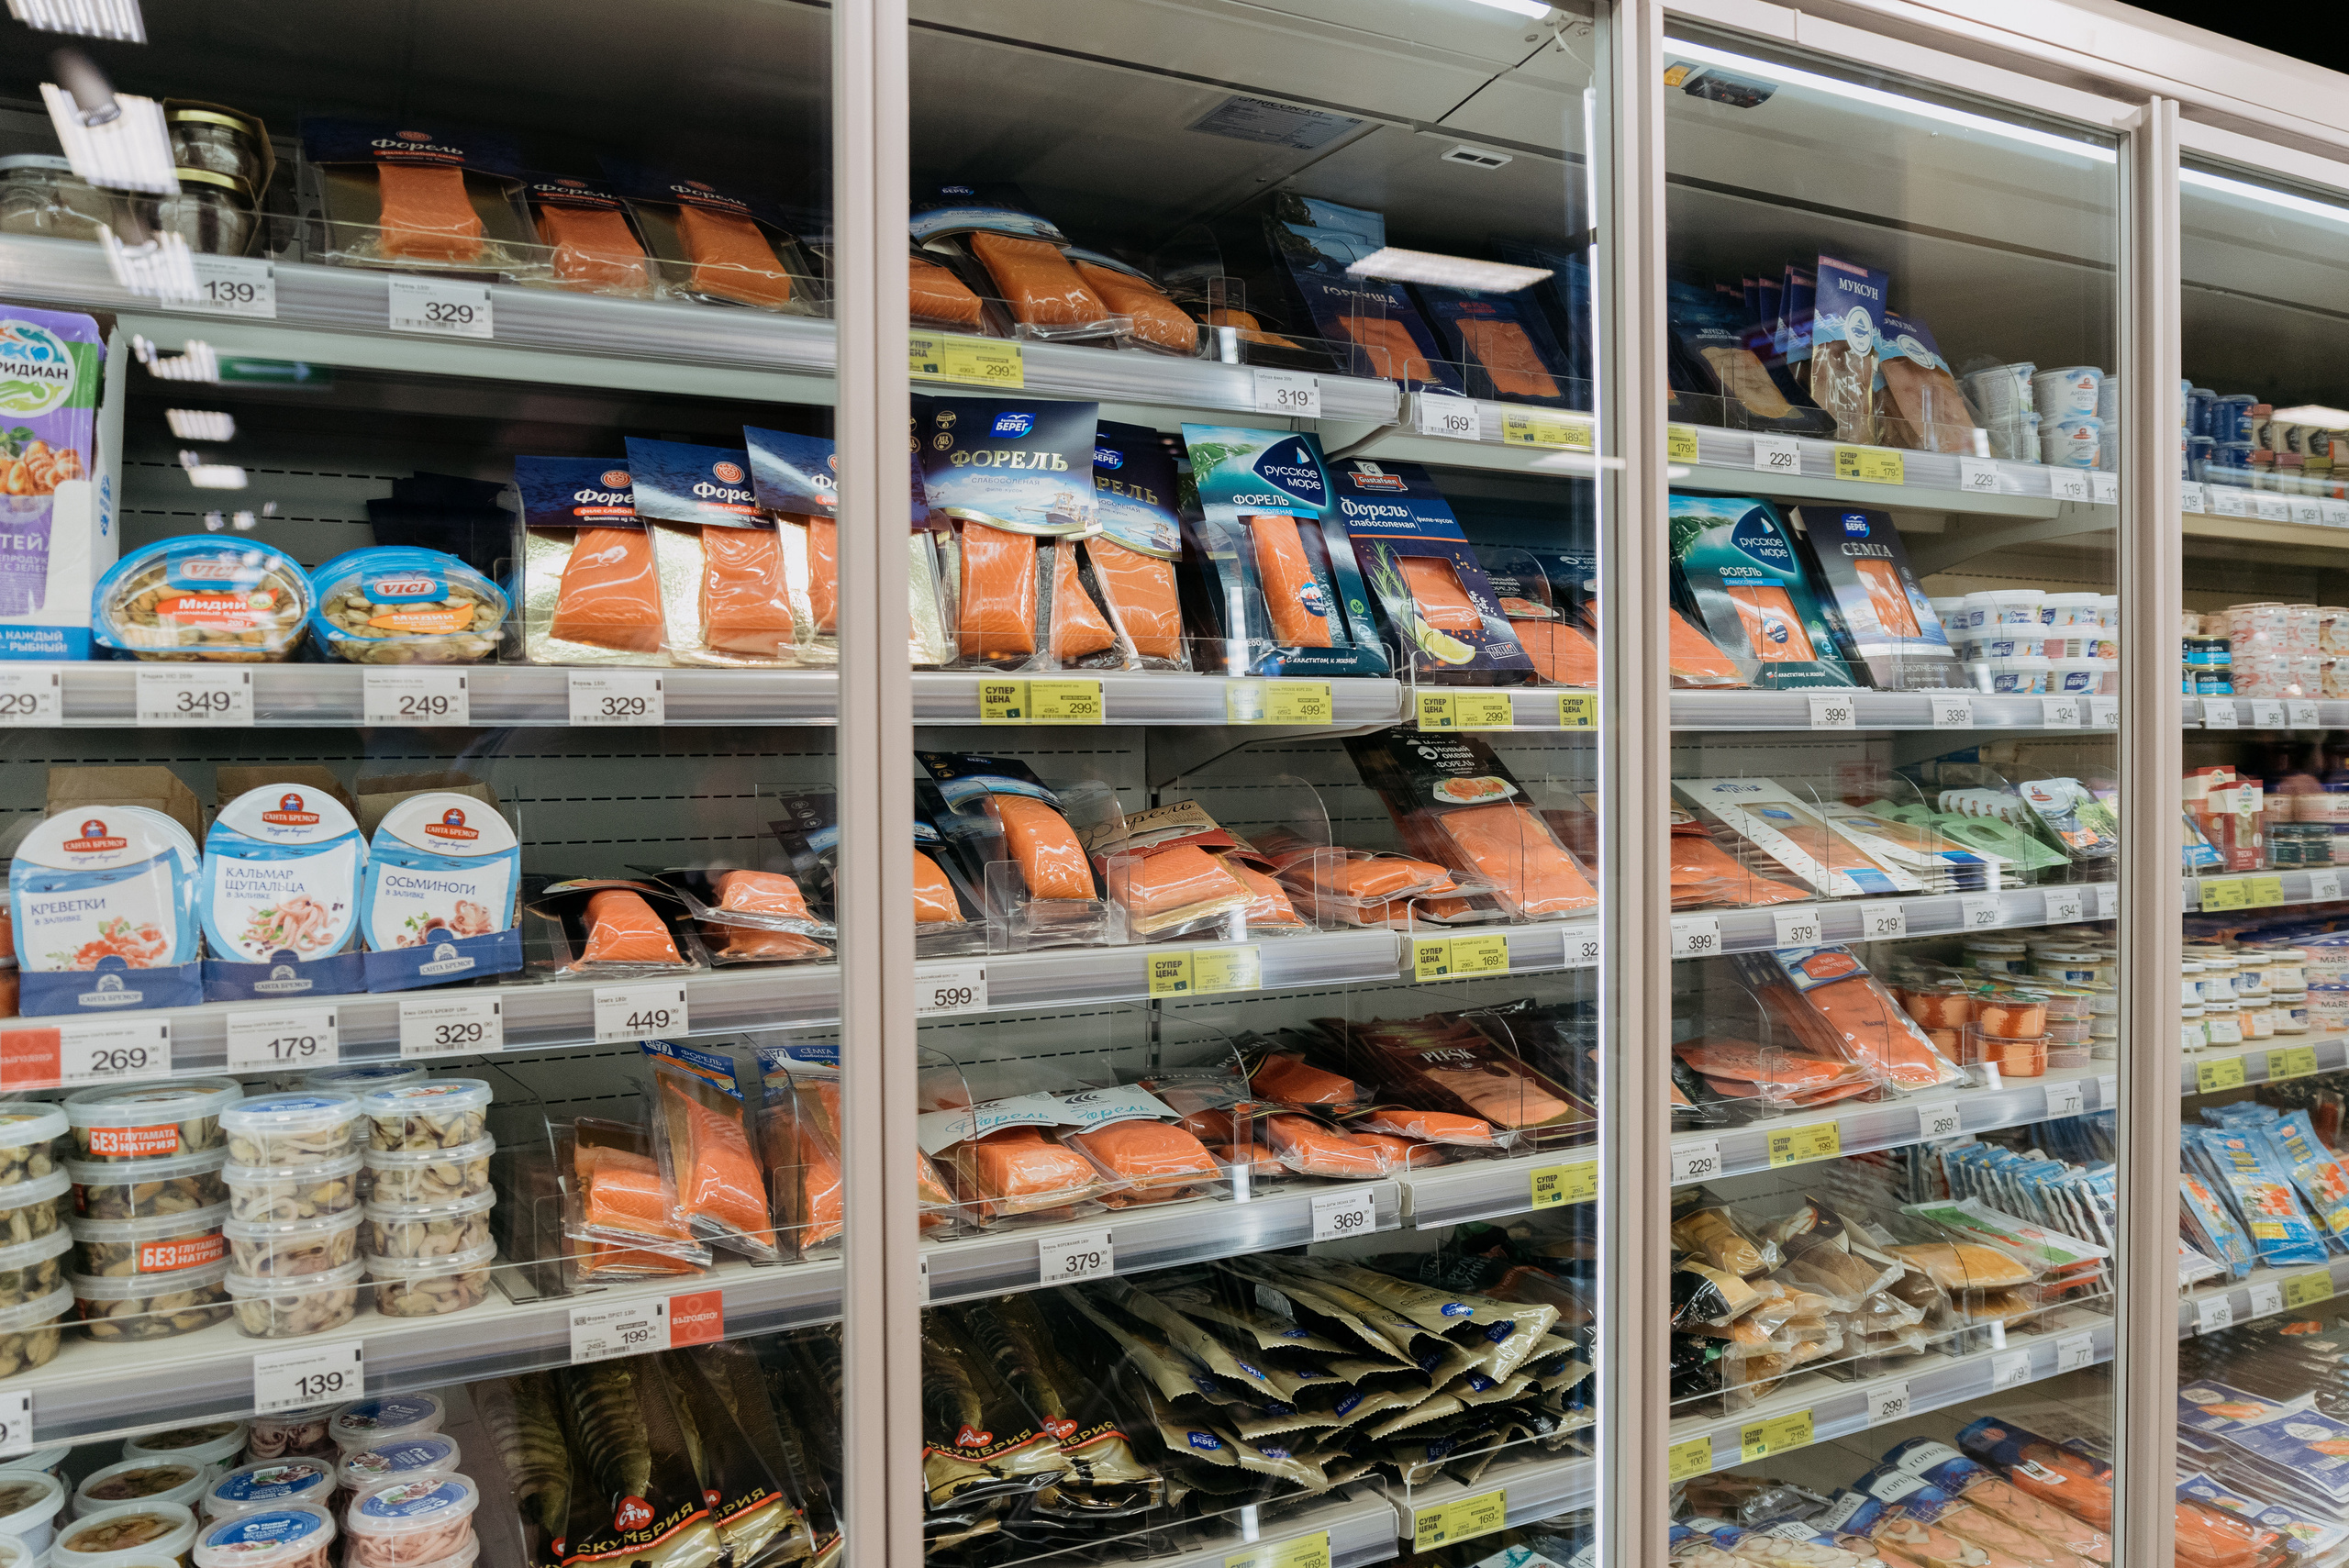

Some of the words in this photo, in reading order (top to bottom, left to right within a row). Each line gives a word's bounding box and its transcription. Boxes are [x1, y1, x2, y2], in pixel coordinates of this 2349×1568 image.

[371, 139, 463, 156] Форель
[670, 184, 748, 207] Форель
[204, 280, 255, 303] 139
[1839, 277, 1879, 301] МУКСУН
[425, 301, 474, 324] 329
[986, 365, 1010, 377] 299
[1277, 389, 1308, 406] 319
[996, 422, 1029, 432] БЕРЕГ
[1442, 415, 1468, 431] 169
[1563, 432, 1579, 442] 189
[1675, 443, 1691, 453] 179
[950, 450, 1069, 473] ФОРЕЛЬ
[1770, 451, 1792, 467] 229
[1840, 458, 1855, 466] ЦЕНА
[1264, 463, 1319, 479] русское
[1883, 468, 1897, 477] 179
[1286, 477, 1322, 491] море
[1358, 475, 1398, 485] Gustafsen
[1974, 473, 1994, 487] 229
[2064, 483, 2081, 495] 119
[573, 489, 635, 508] Форе
[1233, 494, 1289, 506] ФОРЕЛЬ
[580, 507, 601, 516] филе
[1341, 496, 1408, 520] Форель
[1416, 516, 1454, 526] филе-кусок
[1349, 518, 1416, 529] слабосоленая
[1845, 521, 1867, 532] БЕРЕГ
[1739, 536, 1784, 549] русское
[1759, 548, 1788, 559] море
[1841, 541, 1894, 558] СЁМГА
[1719, 566, 1763, 578] ФОРЕЛЬ
[384, 583, 428, 596] VICI
[178, 598, 247, 612] Мидии
[6, 630, 64, 642] КАЖДЫЙ
[2066, 677, 2088, 686] БЕРЕГ
[985, 685, 1016, 697] СУПЕР
[176, 691, 230, 712] 349
[399, 695, 450, 715] 249
[602, 696, 646, 717] 329
[985, 695, 1011, 707] ЦЕНА
[1423, 698, 1448, 707] СУПЕР
[1562, 698, 1585, 706] СУПЕР
[1069, 702, 1092, 716] 299
[1300, 706, 1320, 717] 499
[1423, 706, 1444, 716] ЦЕНА
[1563, 706, 1581, 715] ЦЕНА
[1825, 708, 1847, 722] 399
[1946, 709, 1966, 722] 339
[2056, 707, 2074, 720] 124
[1486, 711, 1504, 723] 299
[1433, 745, 1471, 753] Новый
[1436, 761, 1475, 769] ФОРЕЛЬ
[263, 812, 285, 821] САНТА
[426, 825, 449, 836] САНТА
[450, 828, 478, 839] БРЕМОР
[226, 867, 294, 880] КАЛЬМАР
[225, 880, 306, 894] ЩУПАЛЬЦА
[385, 874, 476, 896] ОСЬМИНОГИ
[30, 897, 106, 917] КРЕВЕТКИ
[2059, 905, 2076, 917] 134
[1976, 910, 1995, 924] 229
[1876, 917, 1898, 932] 219
[1791, 926, 1812, 941] 379
[1688, 934, 1712, 950] 399
[1420, 947, 1443, 956] СУПЕР
[1155, 960, 1184, 970] СУПЕР
[1420, 955, 1440, 964] ЦЕНА
[1481, 955, 1499, 967] 169
[1819, 956, 1836, 965] РЫБА
[1155, 969, 1180, 980] ЦЕНА
[934, 987, 972, 1007] 599
[626, 1009, 669, 1030] 449
[435, 1022, 484, 1045] 329
[267, 1036, 317, 1059] 179
[801, 1047, 834, 1055] СЁМГА
[91, 1048, 148, 1072] 269
[681, 1049, 723, 1067] ФОРЕЛЬ
[2065, 1096, 2076, 1110] 77
[1933, 1118, 1954, 1133] 269
[91, 1130, 118, 1152] БЕЗ
[119, 1129, 176, 1142] ГЛУТАМАТА
[119, 1140, 176, 1152] НАТРИЯ
[1773, 1137, 1791, 1146] СУПЕР
[1818, 1140, 1831, 1152] 199
[1773, 1144, 1789, 1153] ЦЕНА
[1688, 1158, 1713, 1174] 229
[1536, 1174, 1558, 1184] СУПЕР
[1537, 1183, 1555, 1193] ЦЕНА
[1333, 1210, 1364, 1230] 369
[142, 1245, 177, 1268] БЕЗ
[178, 1246, 224, 1264] НАТРИЯ
[1065, 1251, 1101, 1273] 379
[2266, 1296, 2277, 1308] 79
[672, 1311, 718, 1326] ВЫГОДНО!
[2212, 1309, 2227, 1324] 149
[620, 1329, 649, 1345] 199
[2076, 1349, 2087, 1363] 77
[295, 1371, 344, 1396] 139
[1338, 1392, 1361, 1412] БЕРЕГ
[1882, 1397, 1903, 1416] 299
[1744, 1428, 1764, 1440] СУПЕР
[1790, 1430, 1805, 1441] 219
[926, 1428, 1032, 1459] СКУМБРИЯ
[1192, 1436, 1218, 1448] БЕРЕГ
[1744, 1436, 1761, 1447] ЦЕНА
[1419, 1513, 1442, 1525] СУПЕР
[1477, 1512, 1496, 1525] 169
[575, 1501, 696, 1555] СКУМБРИЯ
[1419, 1522, 1439, 1534] ЦЕНА
